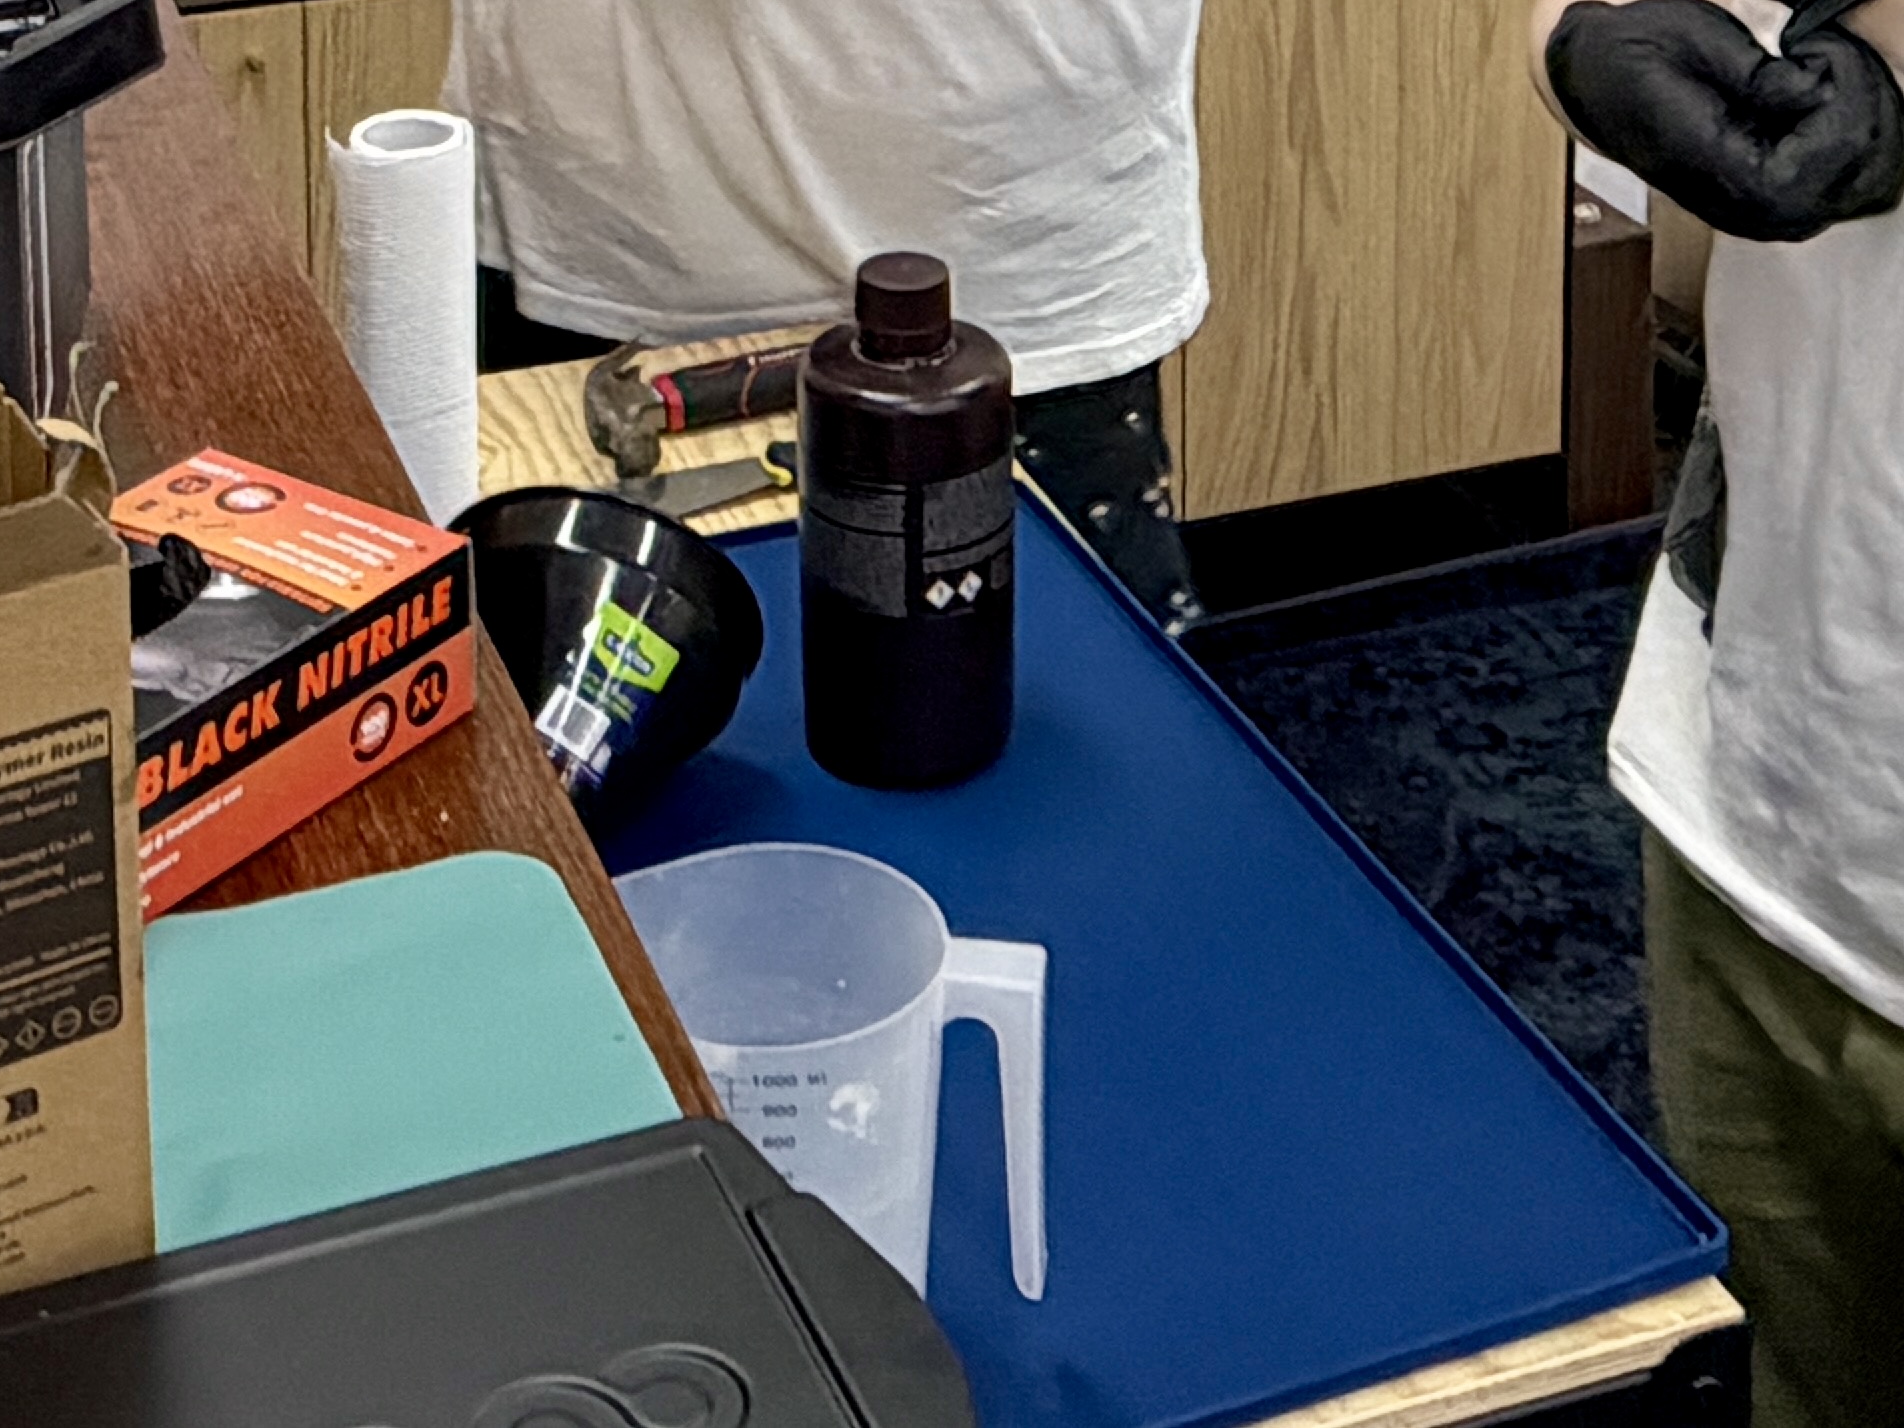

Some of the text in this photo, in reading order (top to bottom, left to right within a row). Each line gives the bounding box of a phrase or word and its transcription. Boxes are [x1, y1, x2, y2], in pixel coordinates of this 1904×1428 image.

[137, 679, 283, 810] BLACK
[296, 574, 453, 712] NITRILE
[411, 672, 445, 719] XL
[49, 730, 105, 764] Resin
[752, 1074, 798, 1088] 1000
